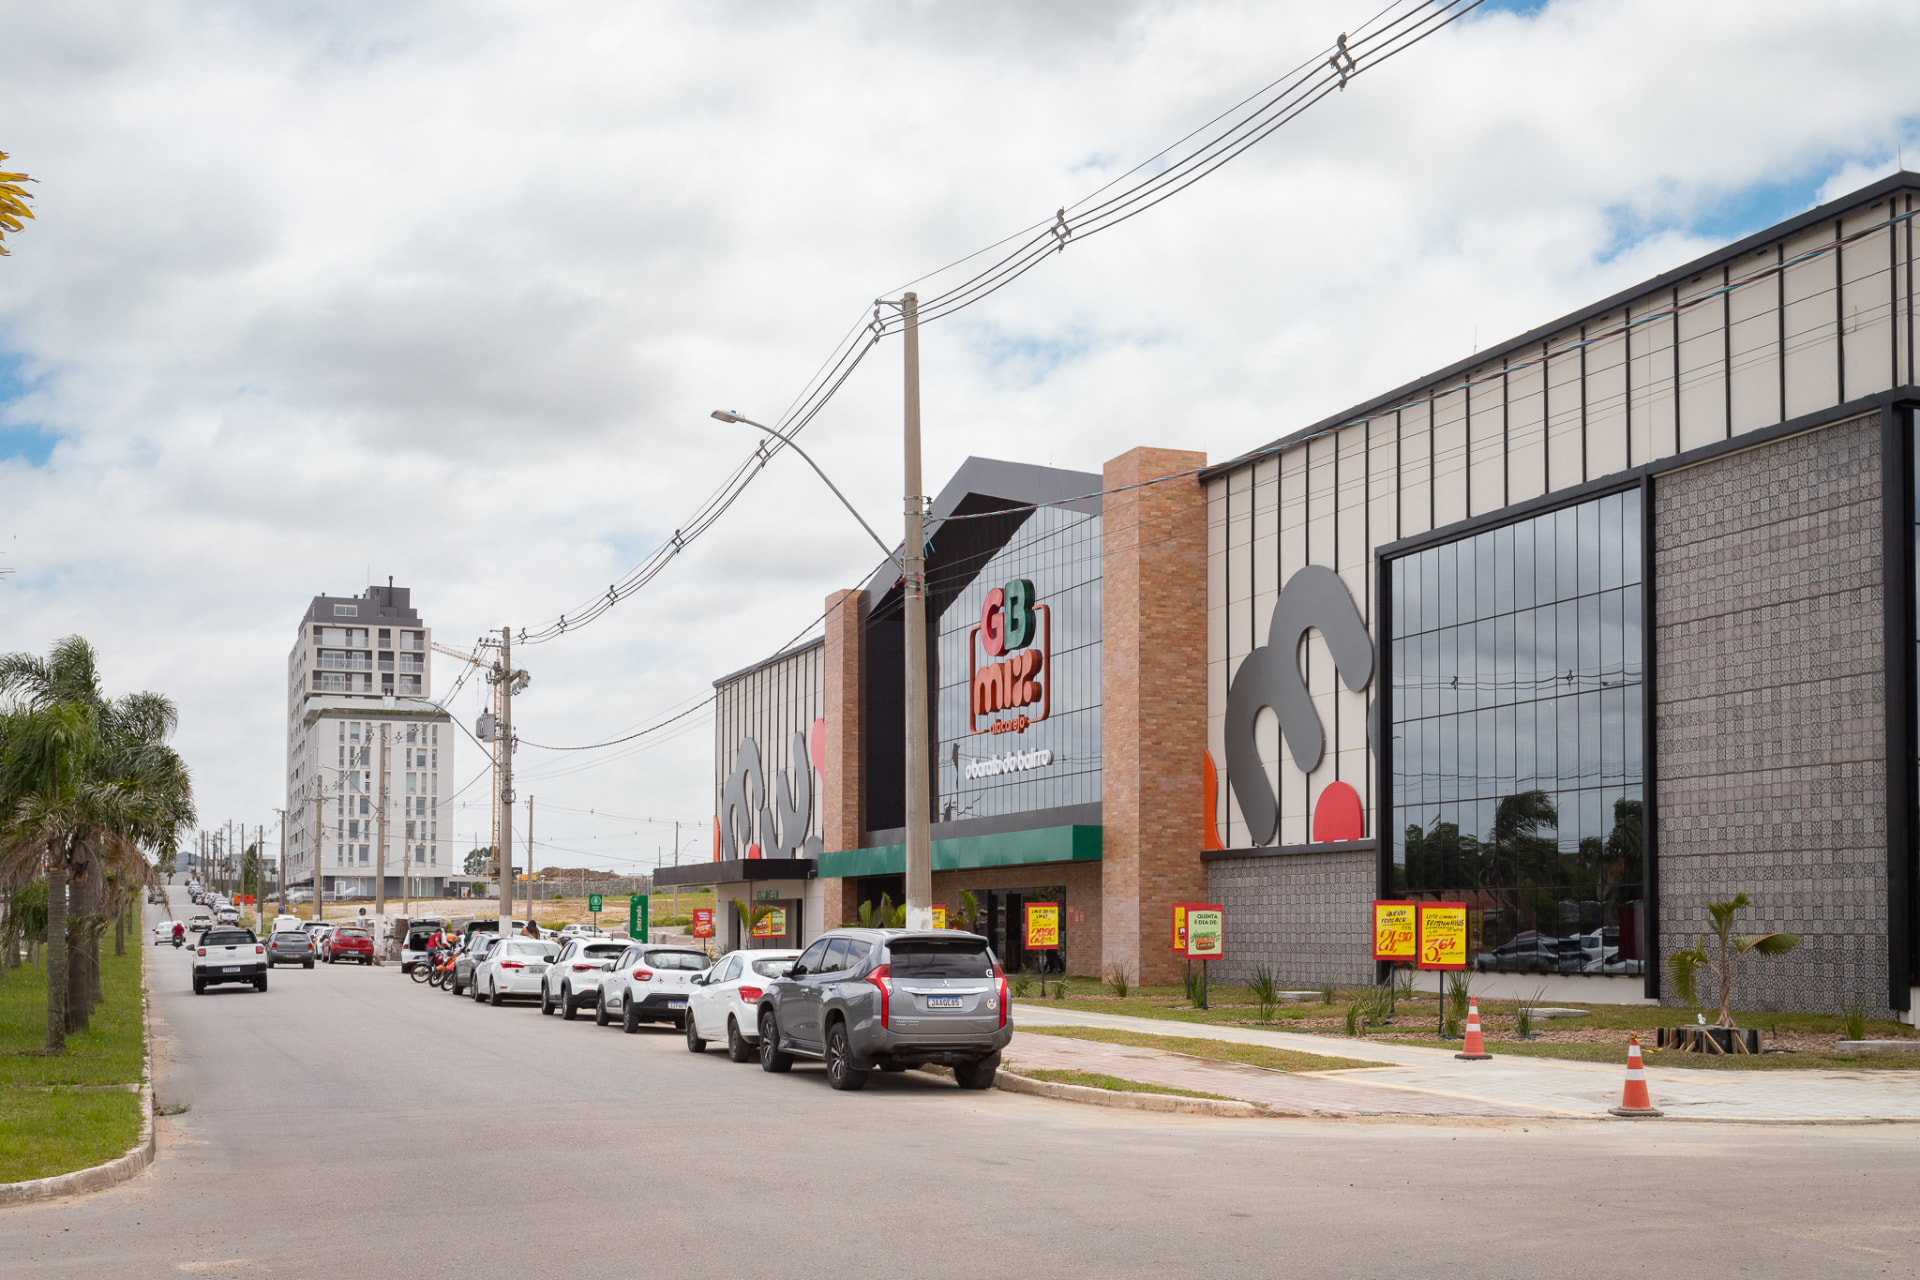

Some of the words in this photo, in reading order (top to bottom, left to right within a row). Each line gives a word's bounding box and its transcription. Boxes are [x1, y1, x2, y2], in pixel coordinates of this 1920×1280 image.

[981, 579, 1036, 656] GB
[974, 649, 1043, 716] mix
[990, 714, 1029, 735] atacarejo
[972, 754, 1003, 779] barato
[1003, 751, 1018, 774] do
[1018, 748, 1053, 771] bairro
[1425, 938, 1456, 962] 3,64
